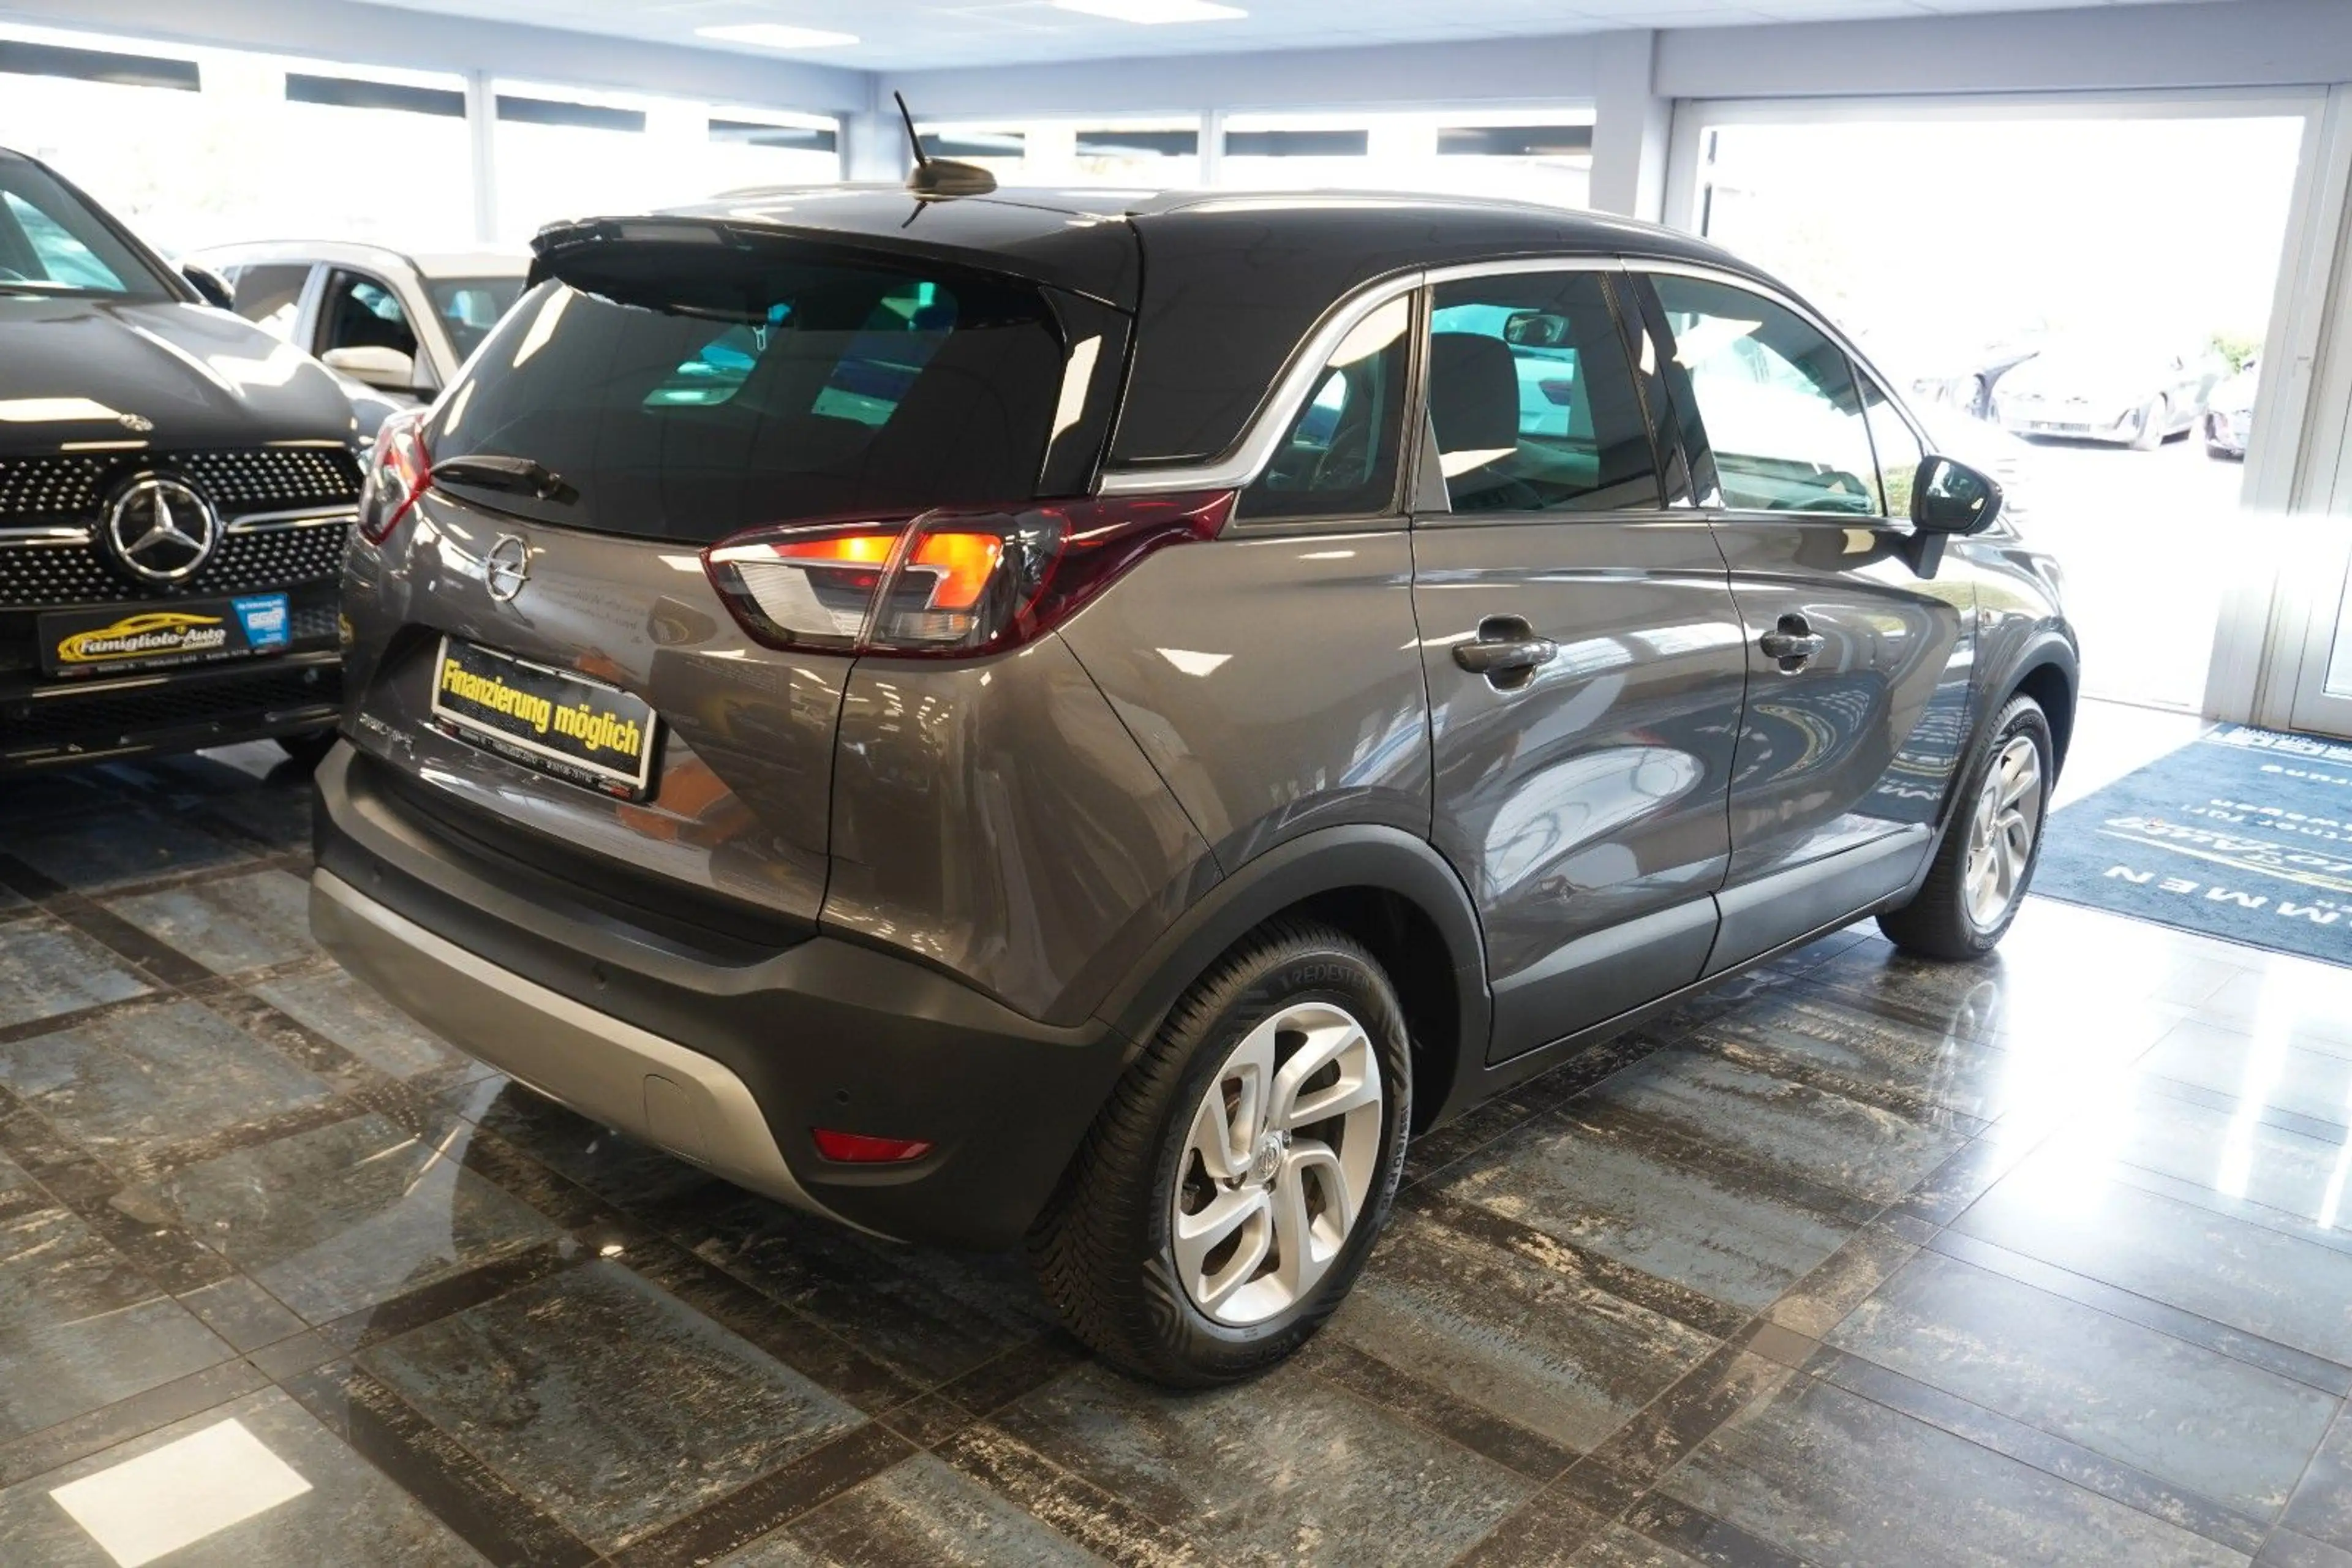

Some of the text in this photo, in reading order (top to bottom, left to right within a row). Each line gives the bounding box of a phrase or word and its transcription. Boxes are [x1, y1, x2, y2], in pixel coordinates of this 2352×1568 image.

[442, 658, 640, 756] Finanzierung möglich
[2103, 865, 2352, 926] MMEN
